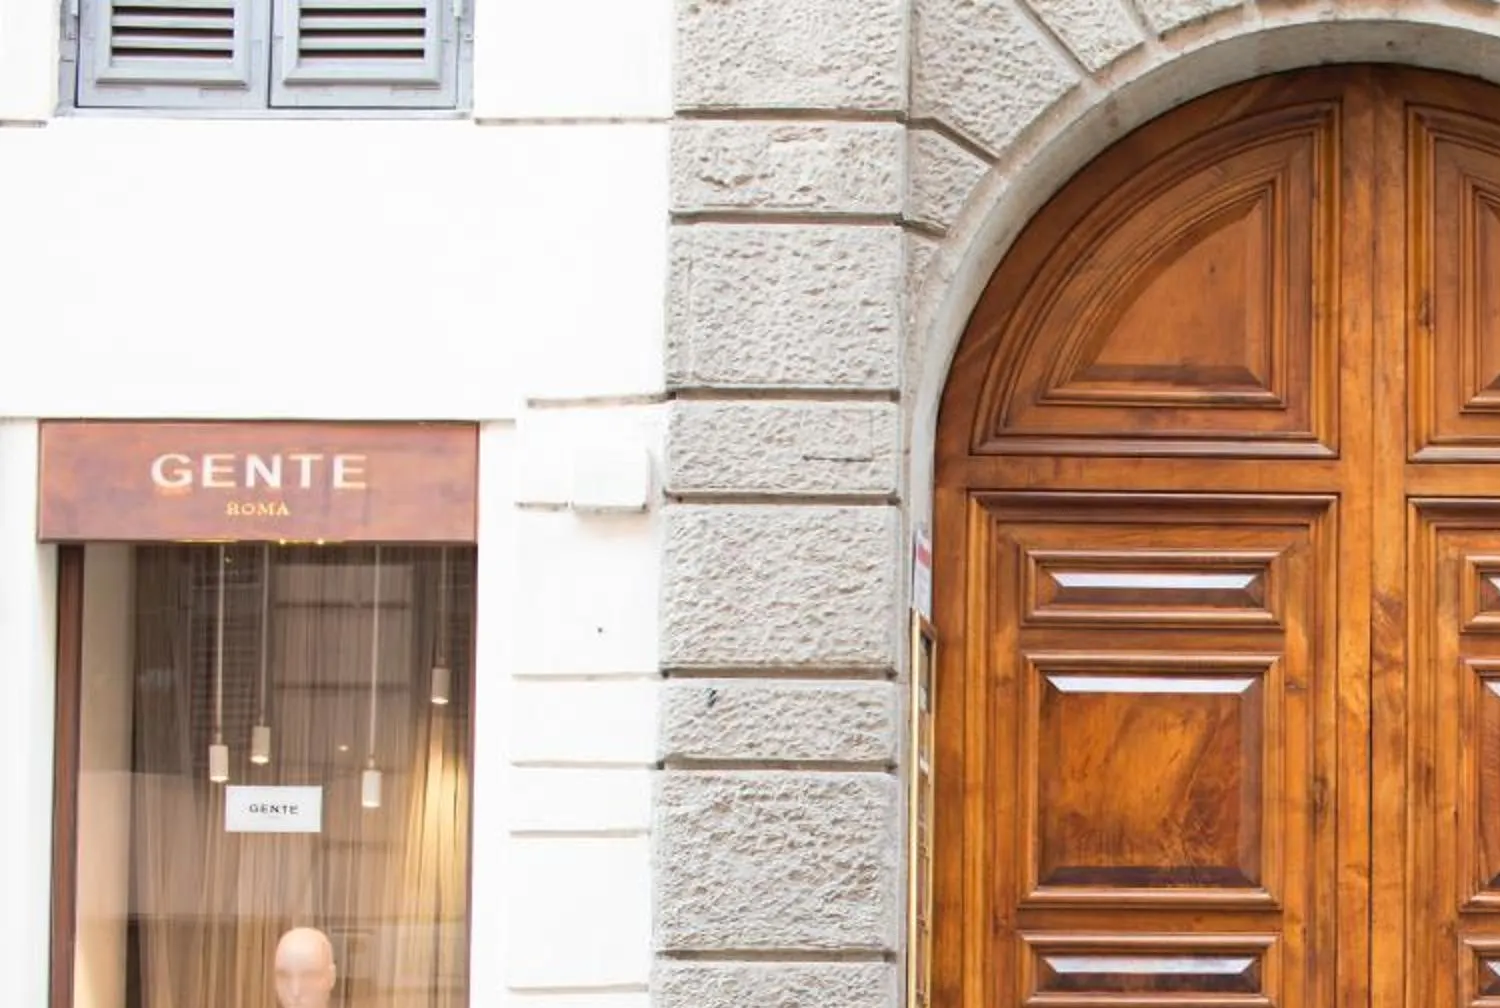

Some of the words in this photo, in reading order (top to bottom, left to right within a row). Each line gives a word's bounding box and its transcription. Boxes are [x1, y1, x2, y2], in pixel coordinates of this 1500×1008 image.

[151, 453, 367, 489] GENTE
[226, 501, 291, 517] ROMA
[248, 803, 300, 815] GENTE
